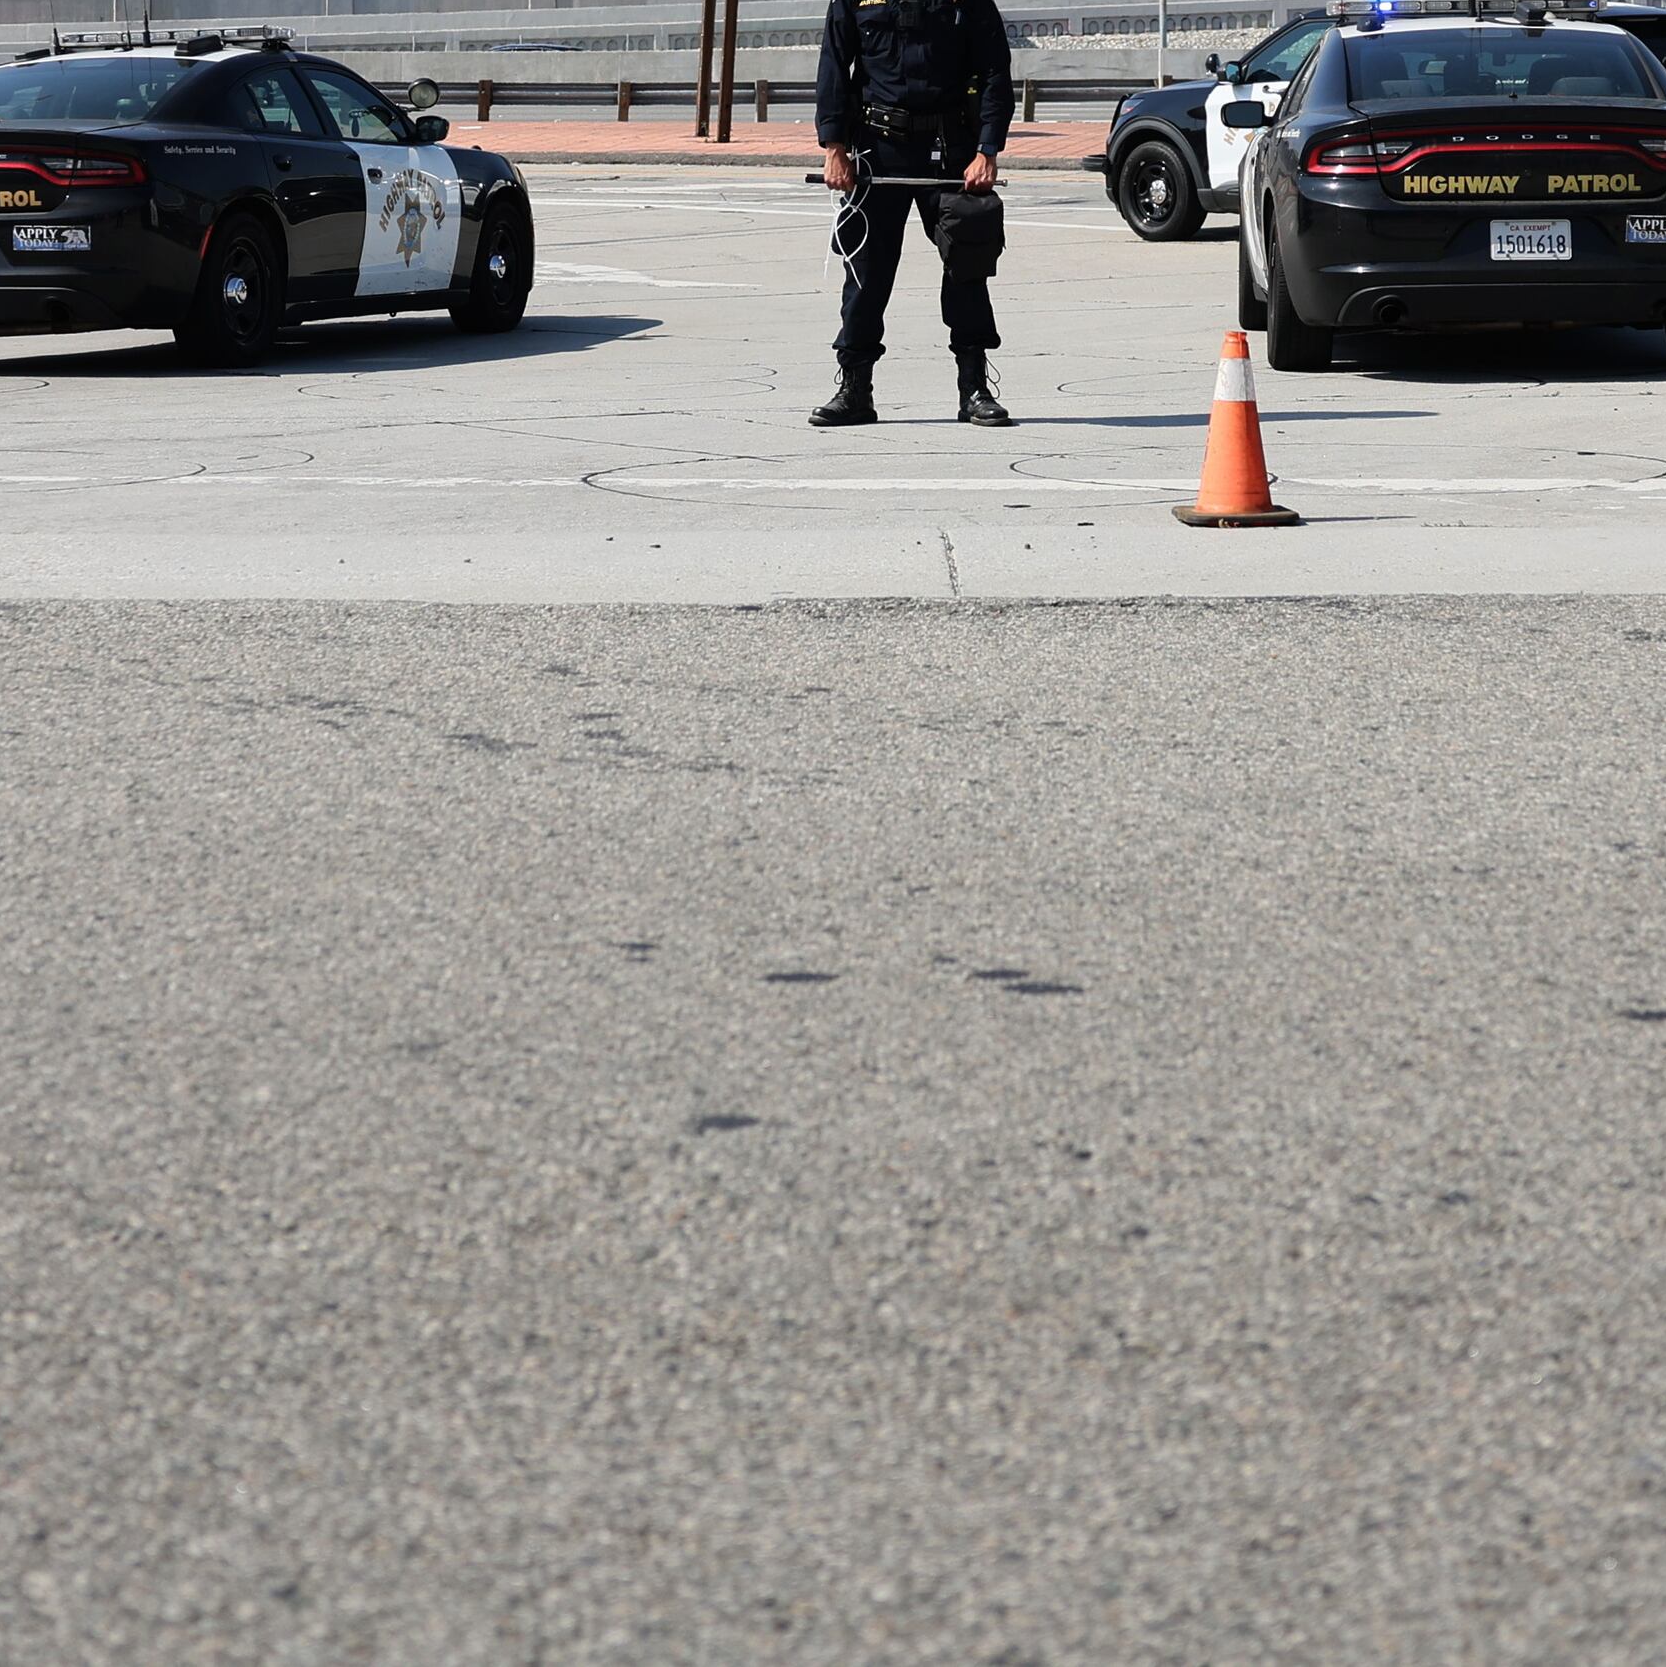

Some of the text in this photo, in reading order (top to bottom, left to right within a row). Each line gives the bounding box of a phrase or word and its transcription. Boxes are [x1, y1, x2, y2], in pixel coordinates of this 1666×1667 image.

[1452, 134, 1601, 142] DODGE
[1403, 173, 1641, 193] HIGHWAY PATROL
[18, 228, 58, 239] APPLY
[19, 238, 58, 248] TODAY!
[1497, 234, 1566, 254] 1501618
